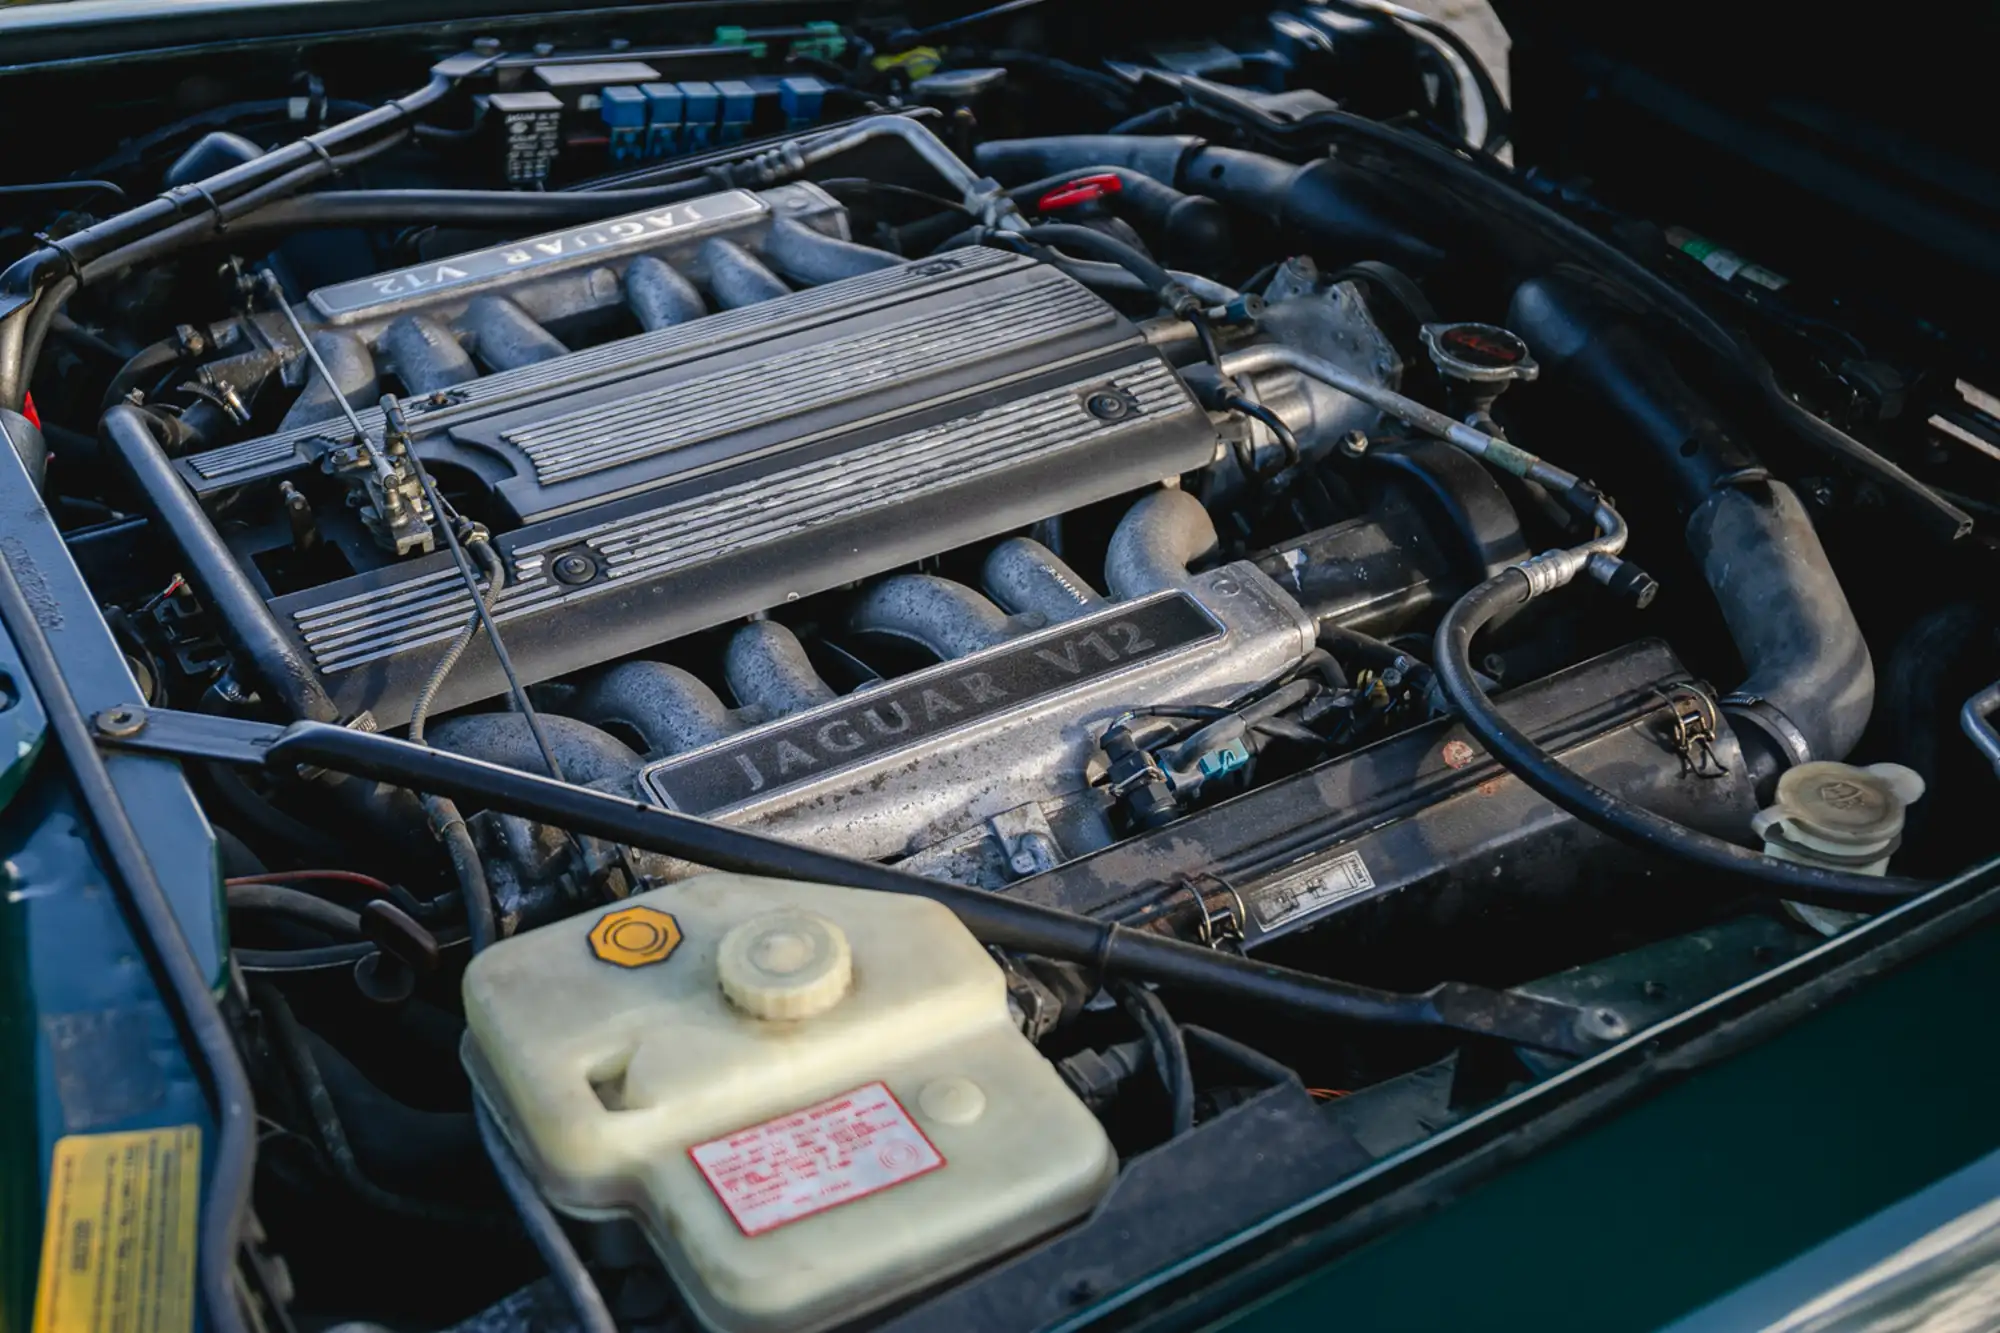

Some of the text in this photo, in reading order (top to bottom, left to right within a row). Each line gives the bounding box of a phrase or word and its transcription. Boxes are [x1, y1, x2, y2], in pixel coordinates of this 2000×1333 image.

[372, 205, 704, 295] JAGUAR V12
[735, 621, 1156, 791] JAGUAR V12
